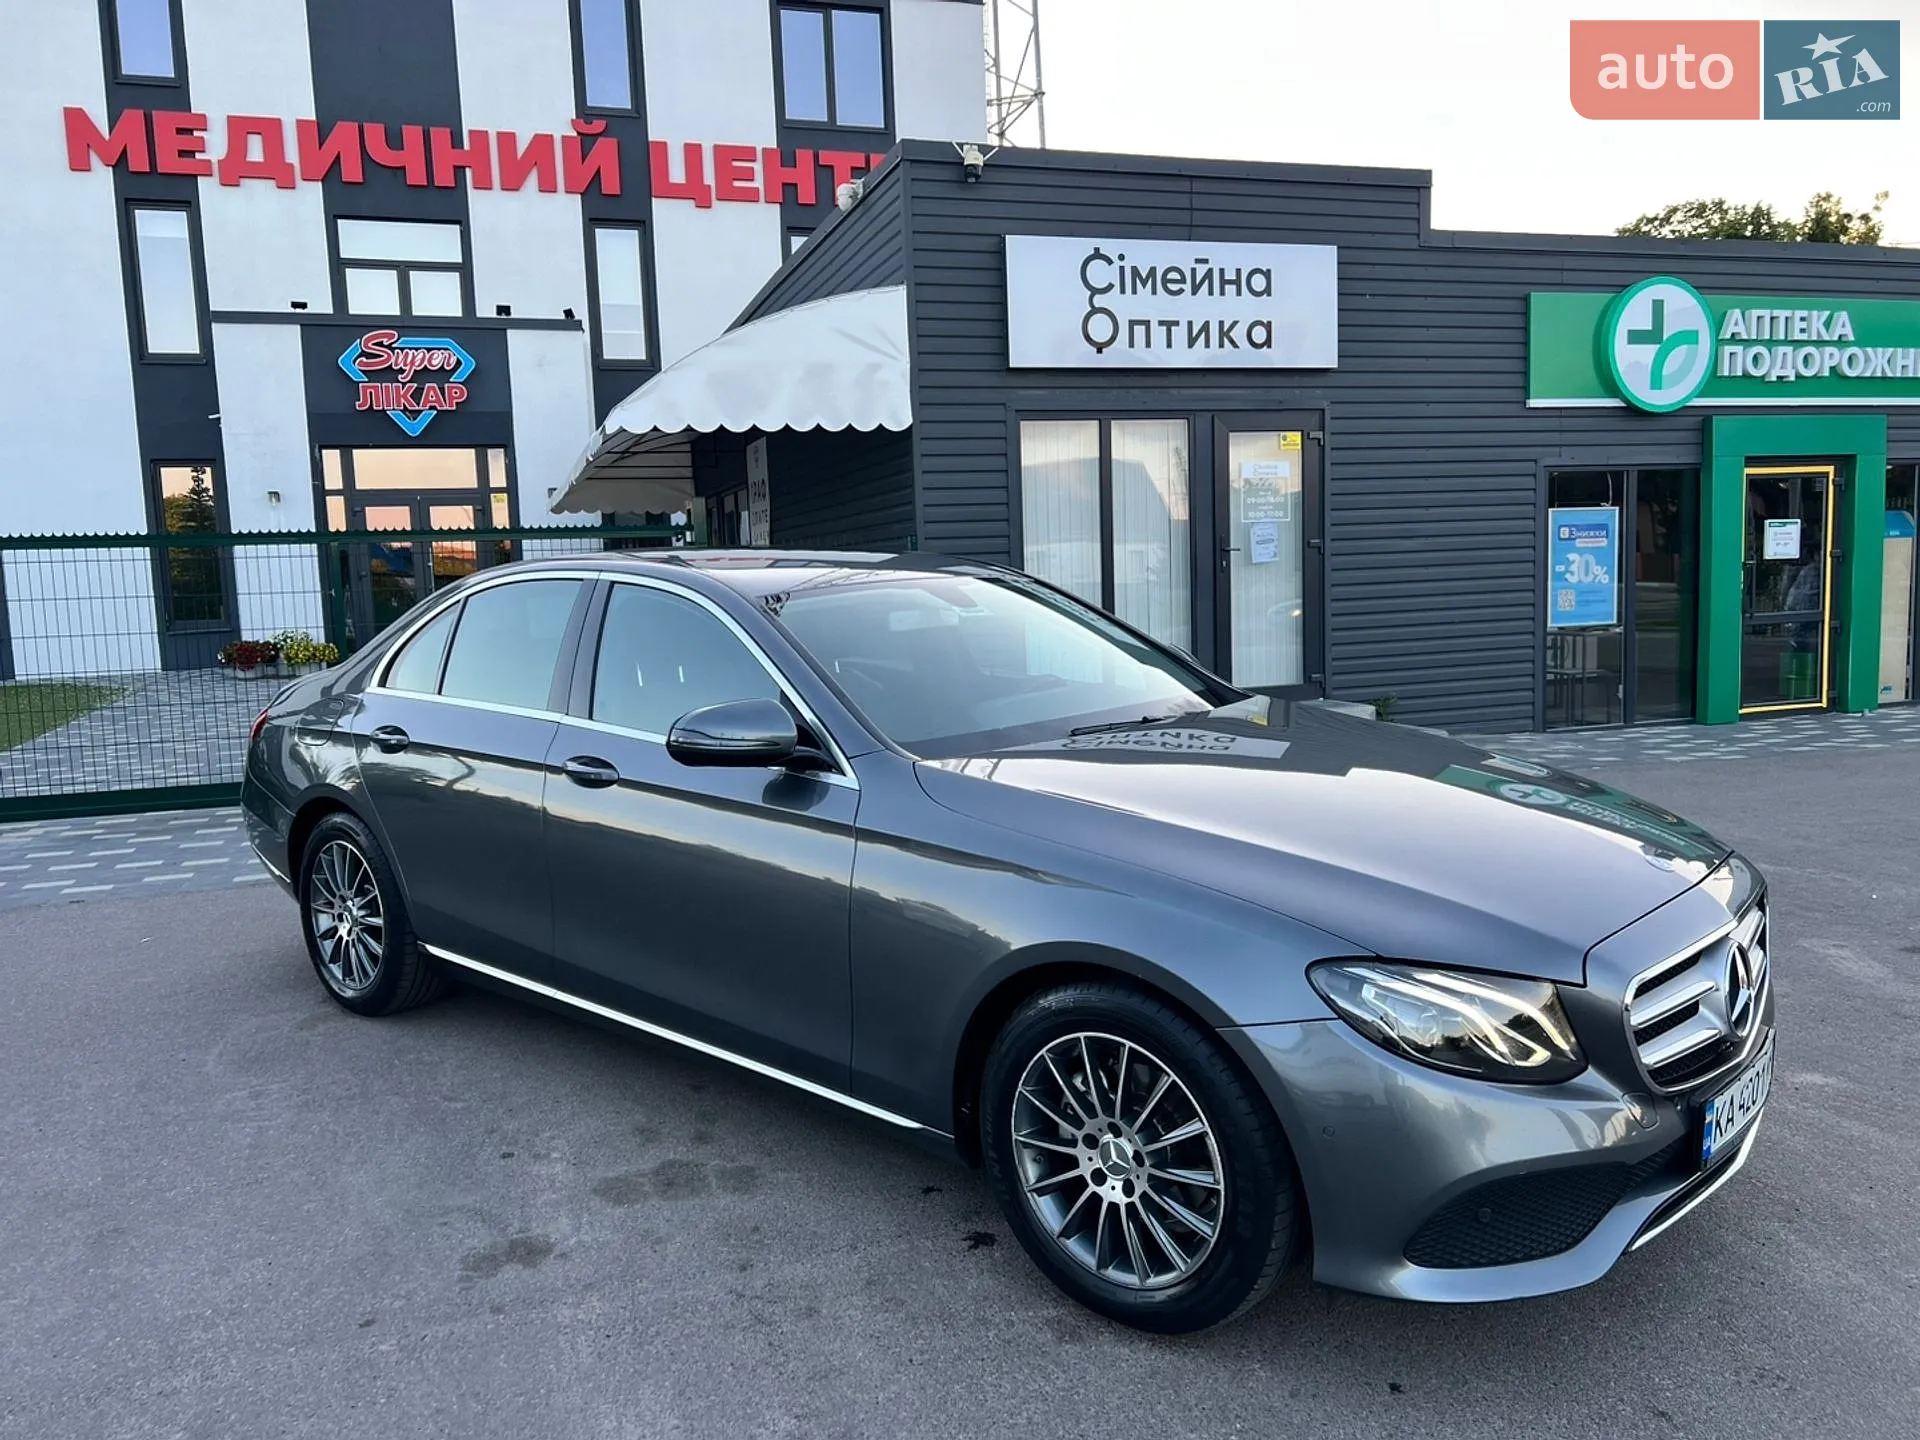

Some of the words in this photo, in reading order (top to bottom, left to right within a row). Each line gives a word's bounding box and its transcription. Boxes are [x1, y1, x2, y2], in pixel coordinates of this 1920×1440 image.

[63, 106, 621, 195] МЕДИЧНИЙ
[648, 140, 889, 209] ЦЕНТ
[1080, 247, 1272, 298] Сімейна
[1082, 306, 1272, 354] Оптика
[1718, 308, 1855, 341] АПТЕКА
[355, 330, 457, 382] Super
[1717, 345, 1920, 382] ПОДОРОЖН
[356, 383, 468, 411] ЛІКАР
[1555, 552, 1609, 584] -30%
[1714, 1093, 1735, 1144] KA
